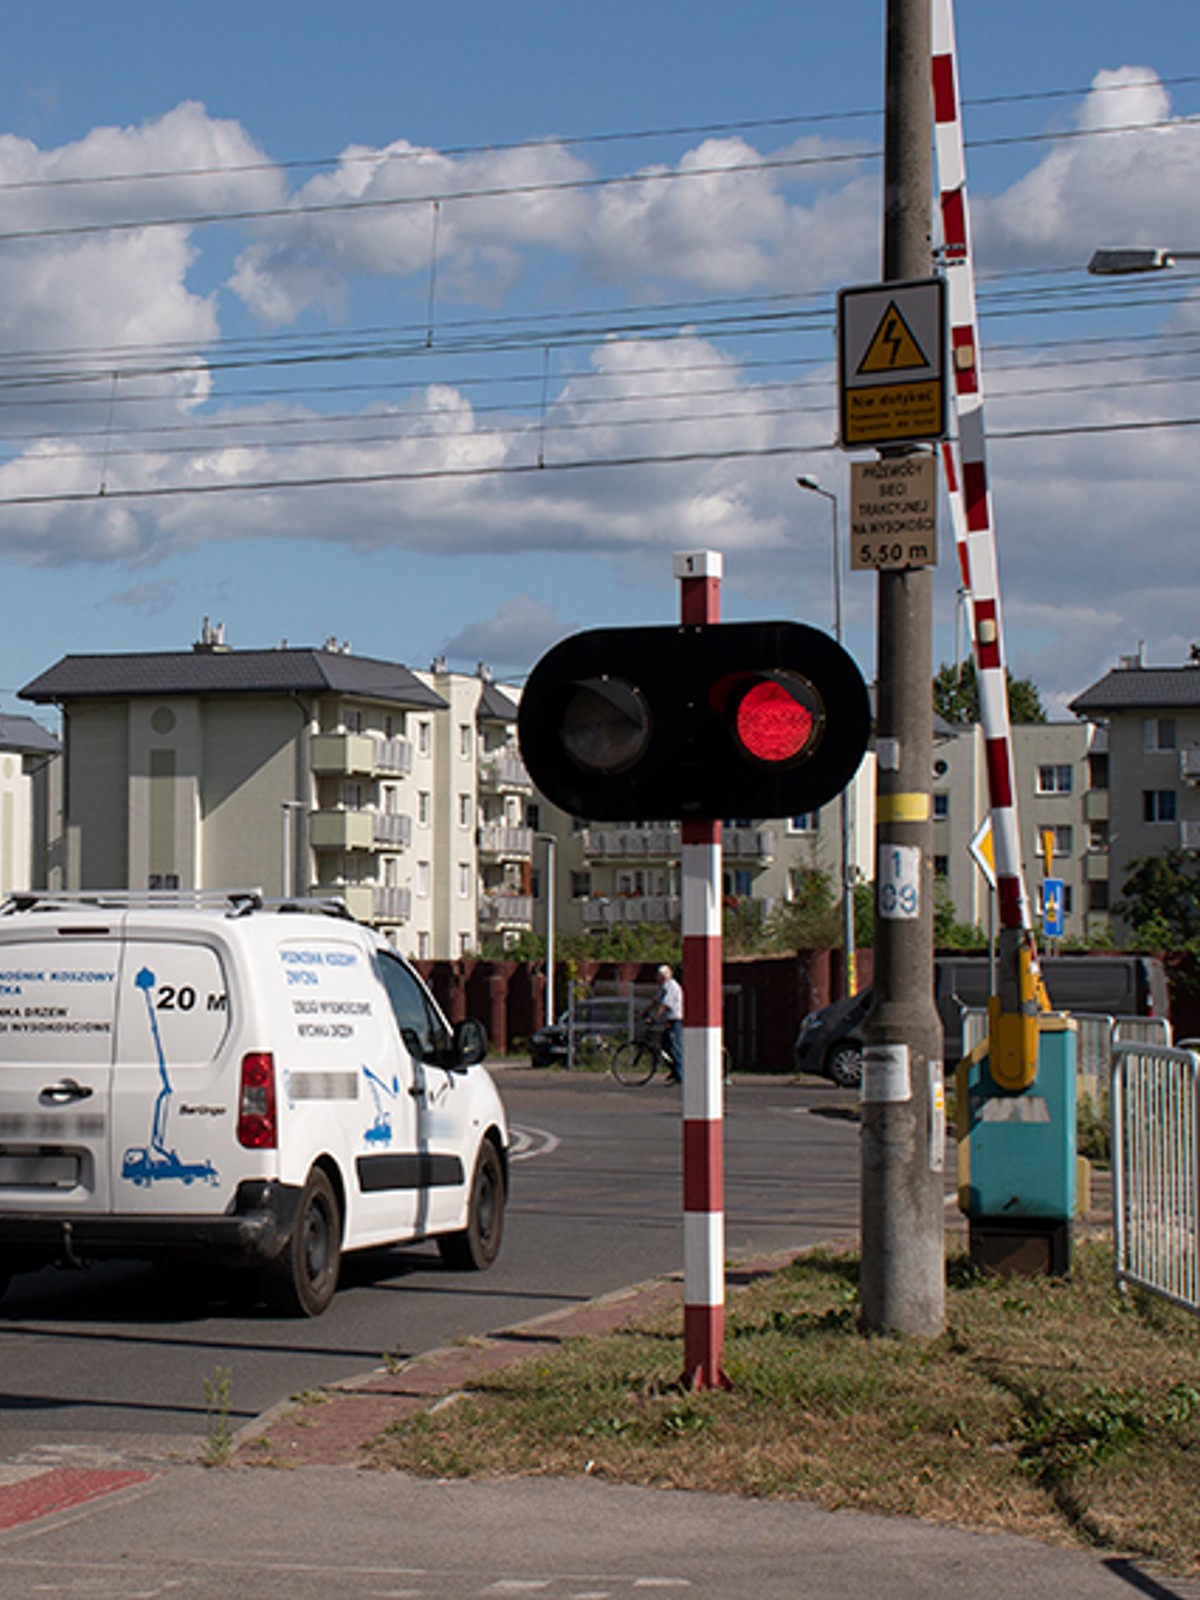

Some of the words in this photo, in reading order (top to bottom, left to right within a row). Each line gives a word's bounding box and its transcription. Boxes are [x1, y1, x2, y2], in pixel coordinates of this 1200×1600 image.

[909, 544, 928, 559] m
[892, 850, 902, 878] 1
[157, 986, 196, 1011] 20
